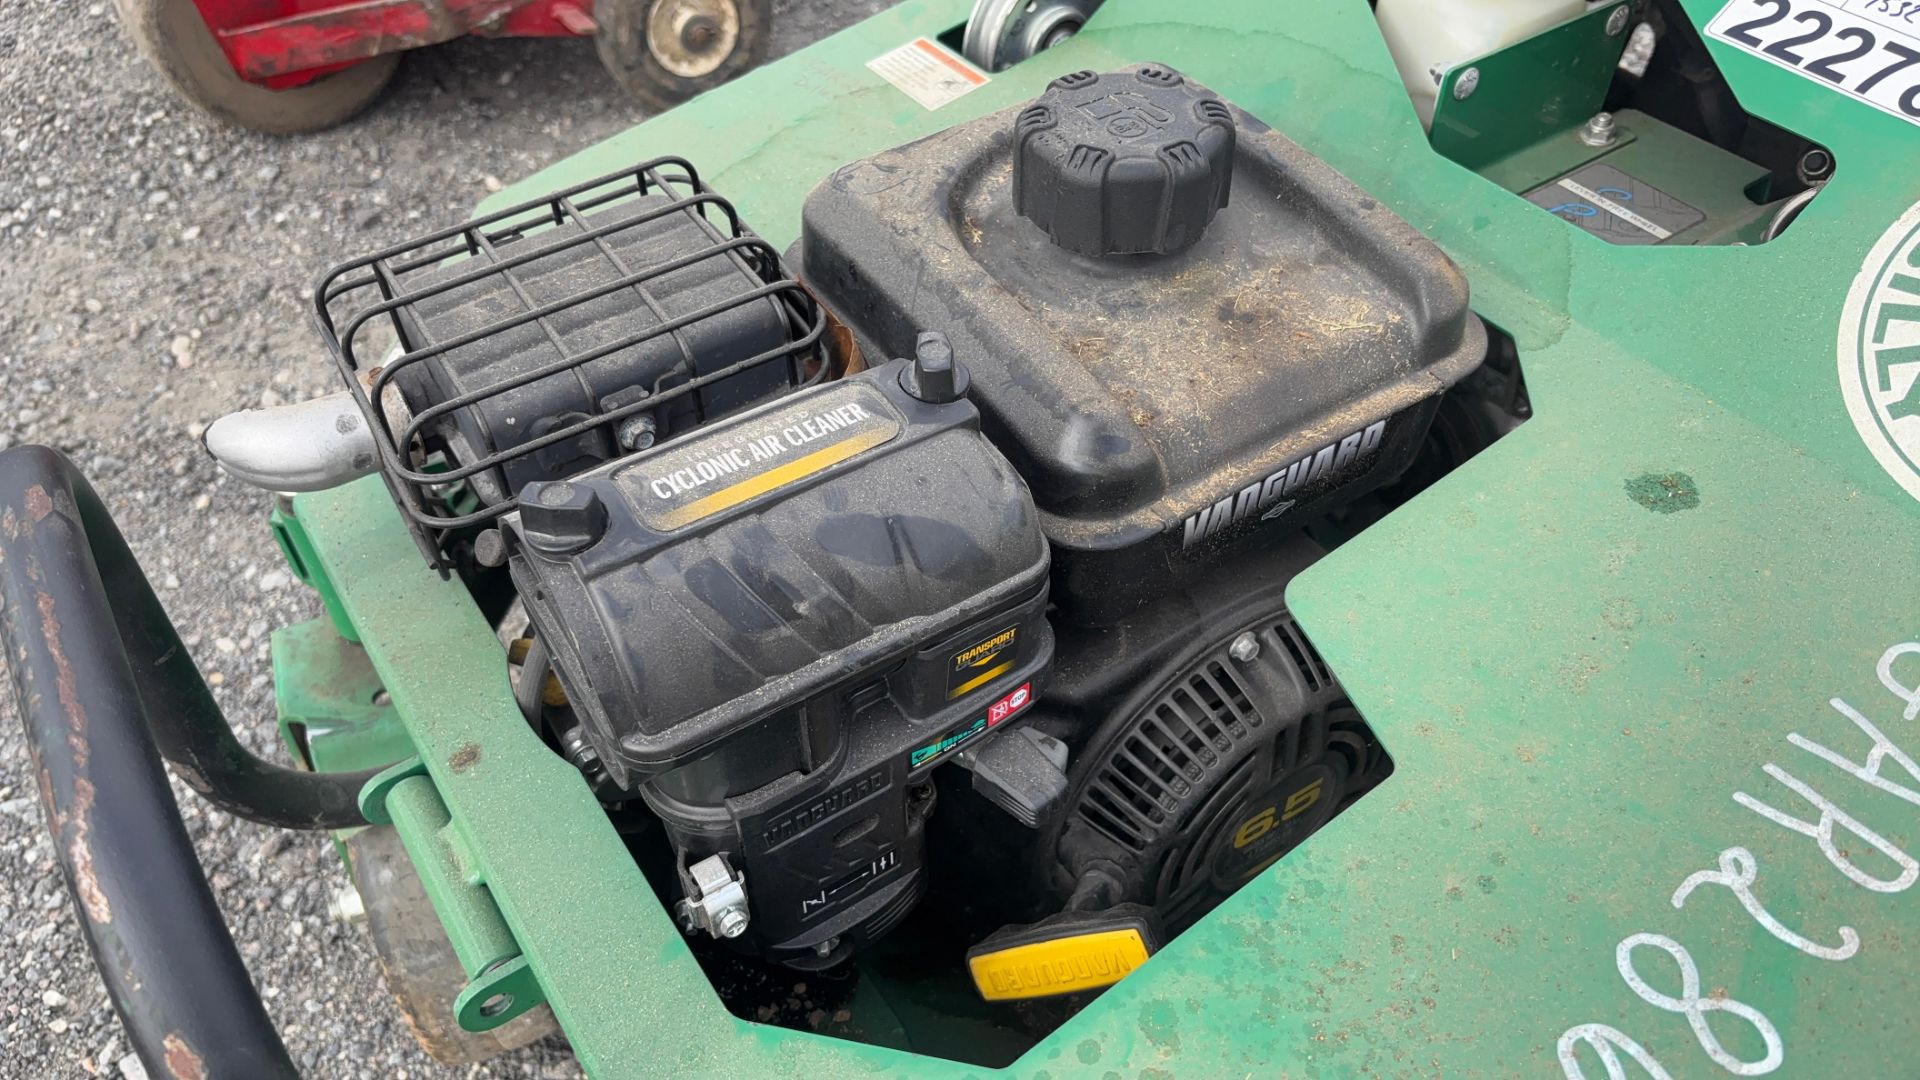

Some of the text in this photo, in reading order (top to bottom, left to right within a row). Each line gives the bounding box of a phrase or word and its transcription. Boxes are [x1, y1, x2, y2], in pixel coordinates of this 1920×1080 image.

[650, 402, 870, 500] CYCLONIC AIR CLEANER
[1183, 420, 1387, 550] VANGUARD
[955, 628, 1017, 665] TRANSPORT
[1010, 690, 1027, 705] STOP
[1233, 777, 1324, 848] 6.5
[986, 947, 1132, 993] VANGUARD
